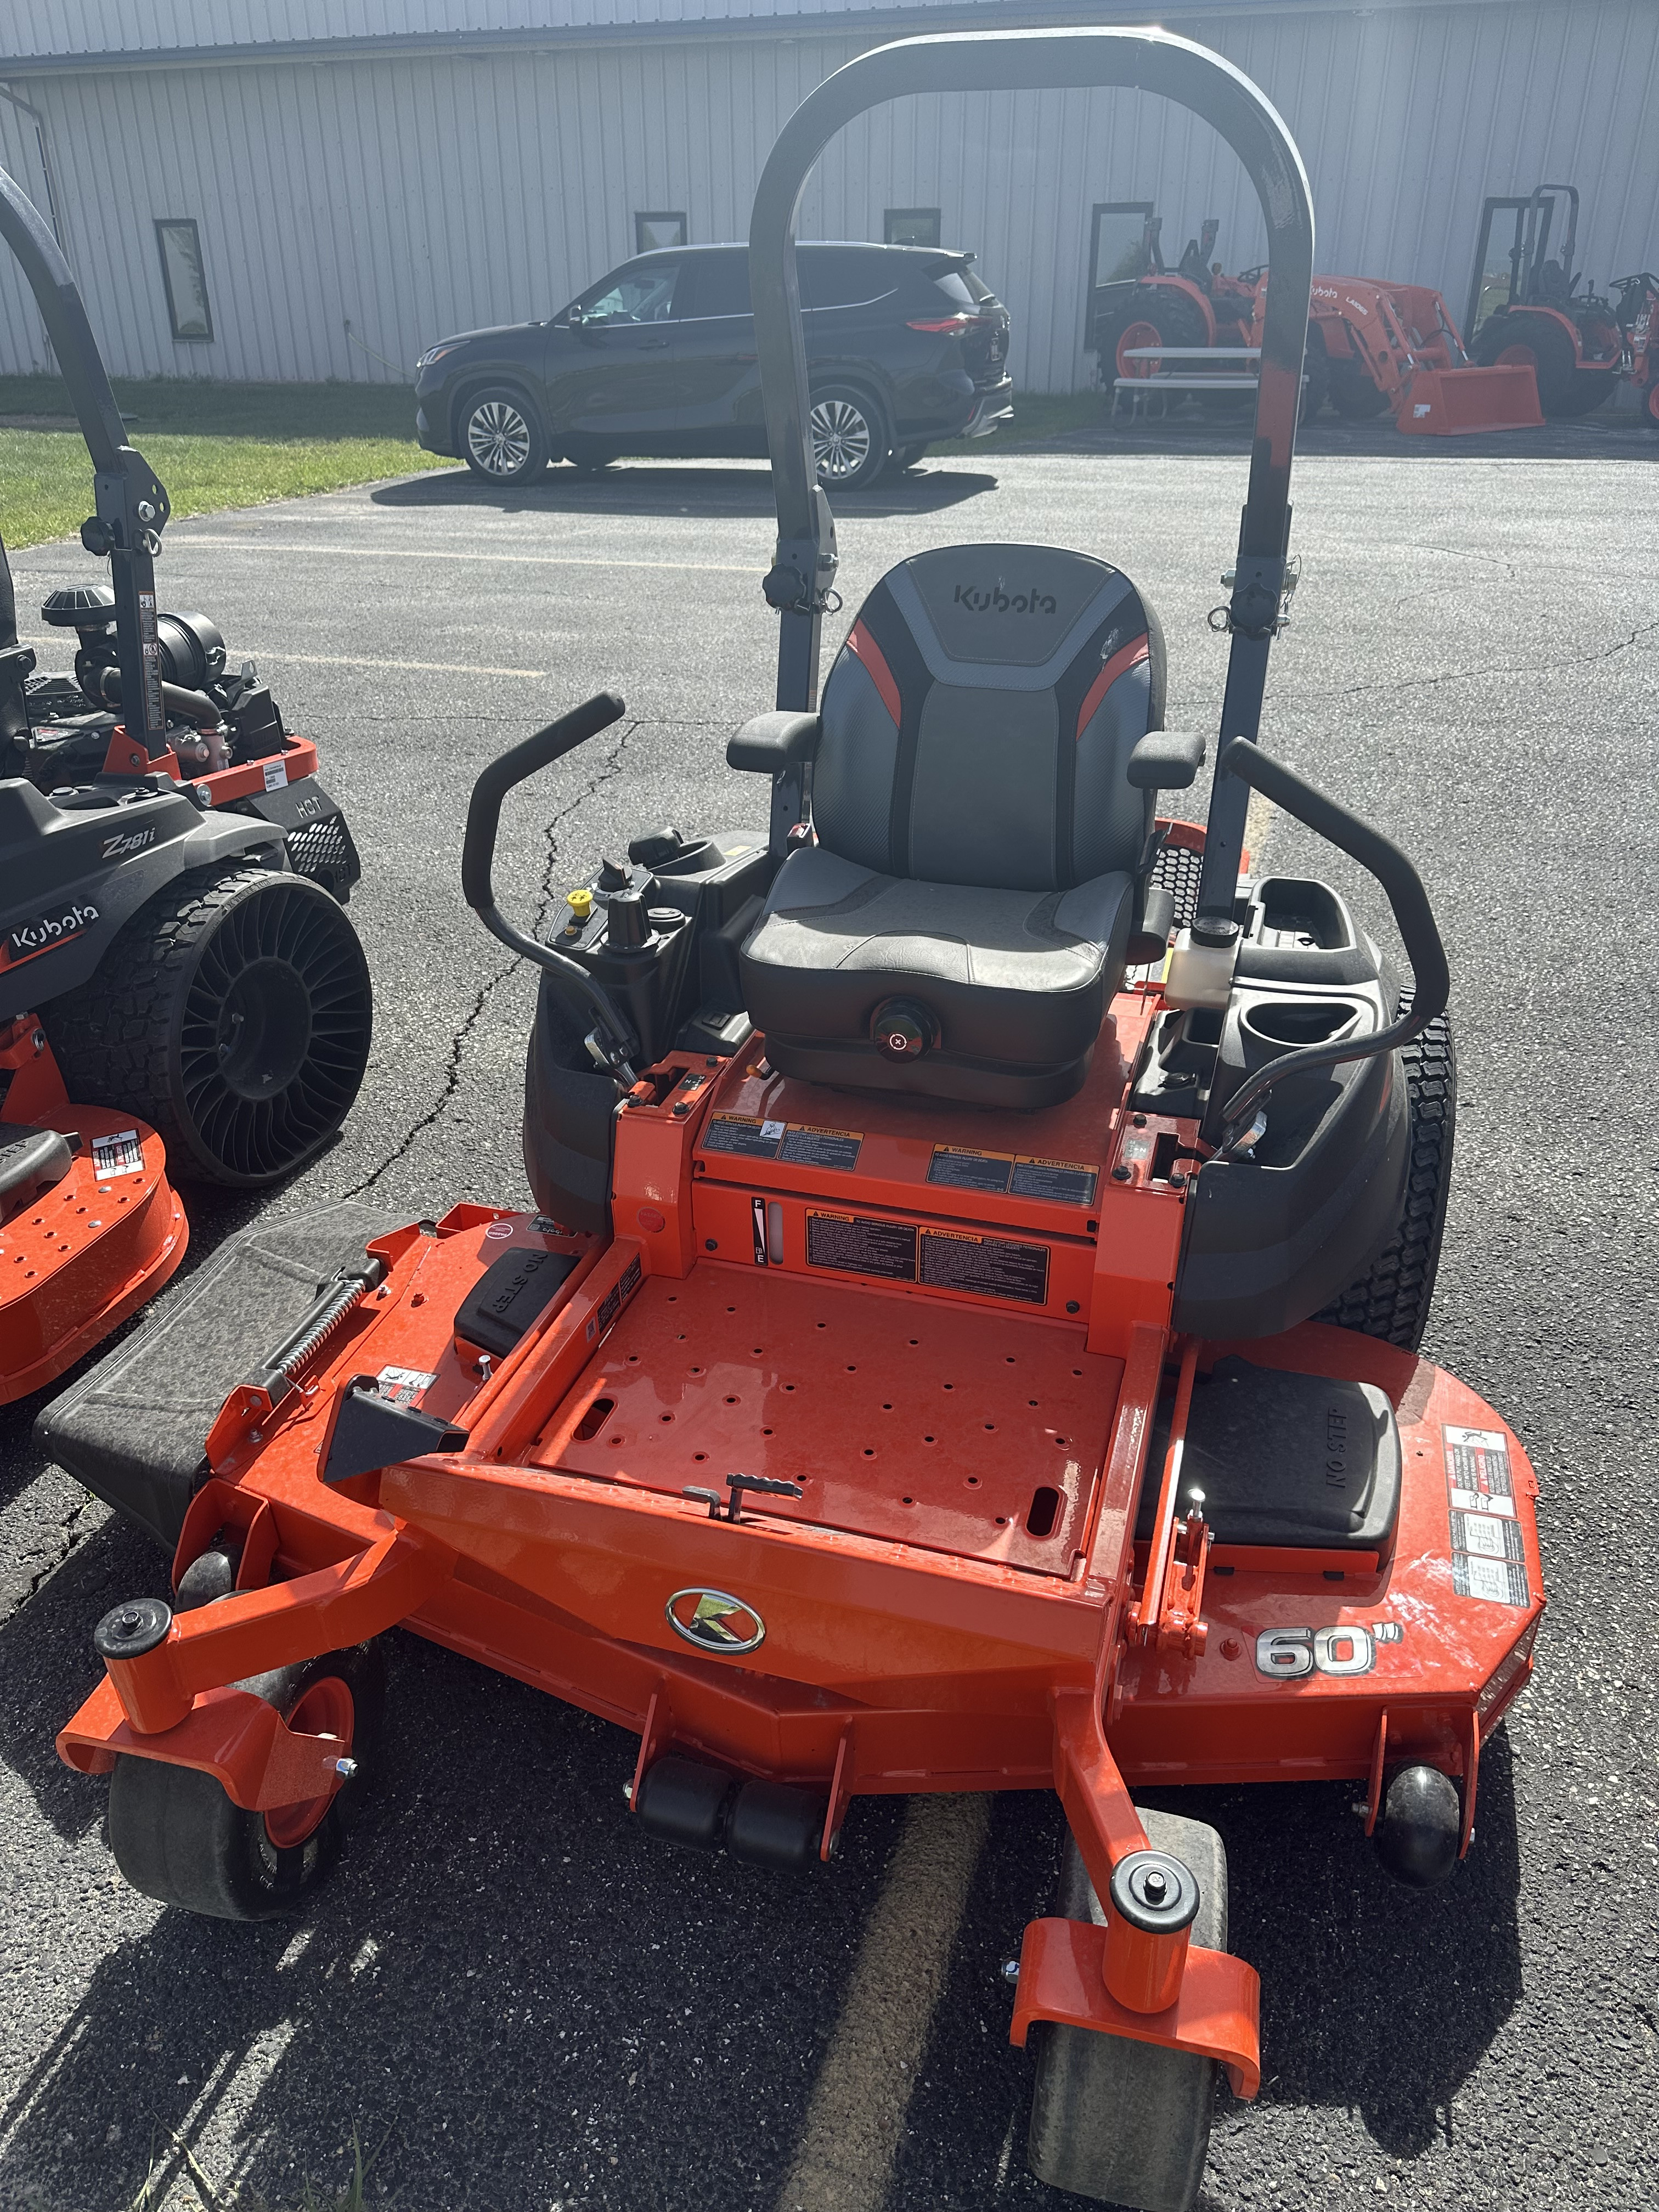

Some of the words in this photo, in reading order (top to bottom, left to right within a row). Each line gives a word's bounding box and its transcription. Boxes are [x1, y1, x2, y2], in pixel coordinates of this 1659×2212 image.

[953, 585, 1057, 614] Kubota
[295, 795, 322, 819] HOT
[102, 827, 156, 859] Z781i
[12, 906, 99, 947] Kubota
[729, 1115, 757, 1124] WARNING
[807, 1126, 850, 1137] ADVERTENCIA
[951, 1147, 982, 1156] WARNING
[1037, 1159, 1085, 1170] ADVERTENCIA
[755, 1199, 761, 1207] F
[820, 1212, 850, 1221] WARNING
[933, 1231, 979, 1242] ADVERTENCIA
[523, 1254, 548, 1272] NO
[757, 1255, 764, 1263] E
[492, 1274, 528, 1313] STEP
[1327, 1407, 1347, 1453] STEP
[1446, 1449, 1455, 1474] DANGER
[1477, 1454, 1487, 1480] PELIGRO
[1326, 1460, 1346, 1488] NO
[1256, 1622, 1400, 1677] 60"
